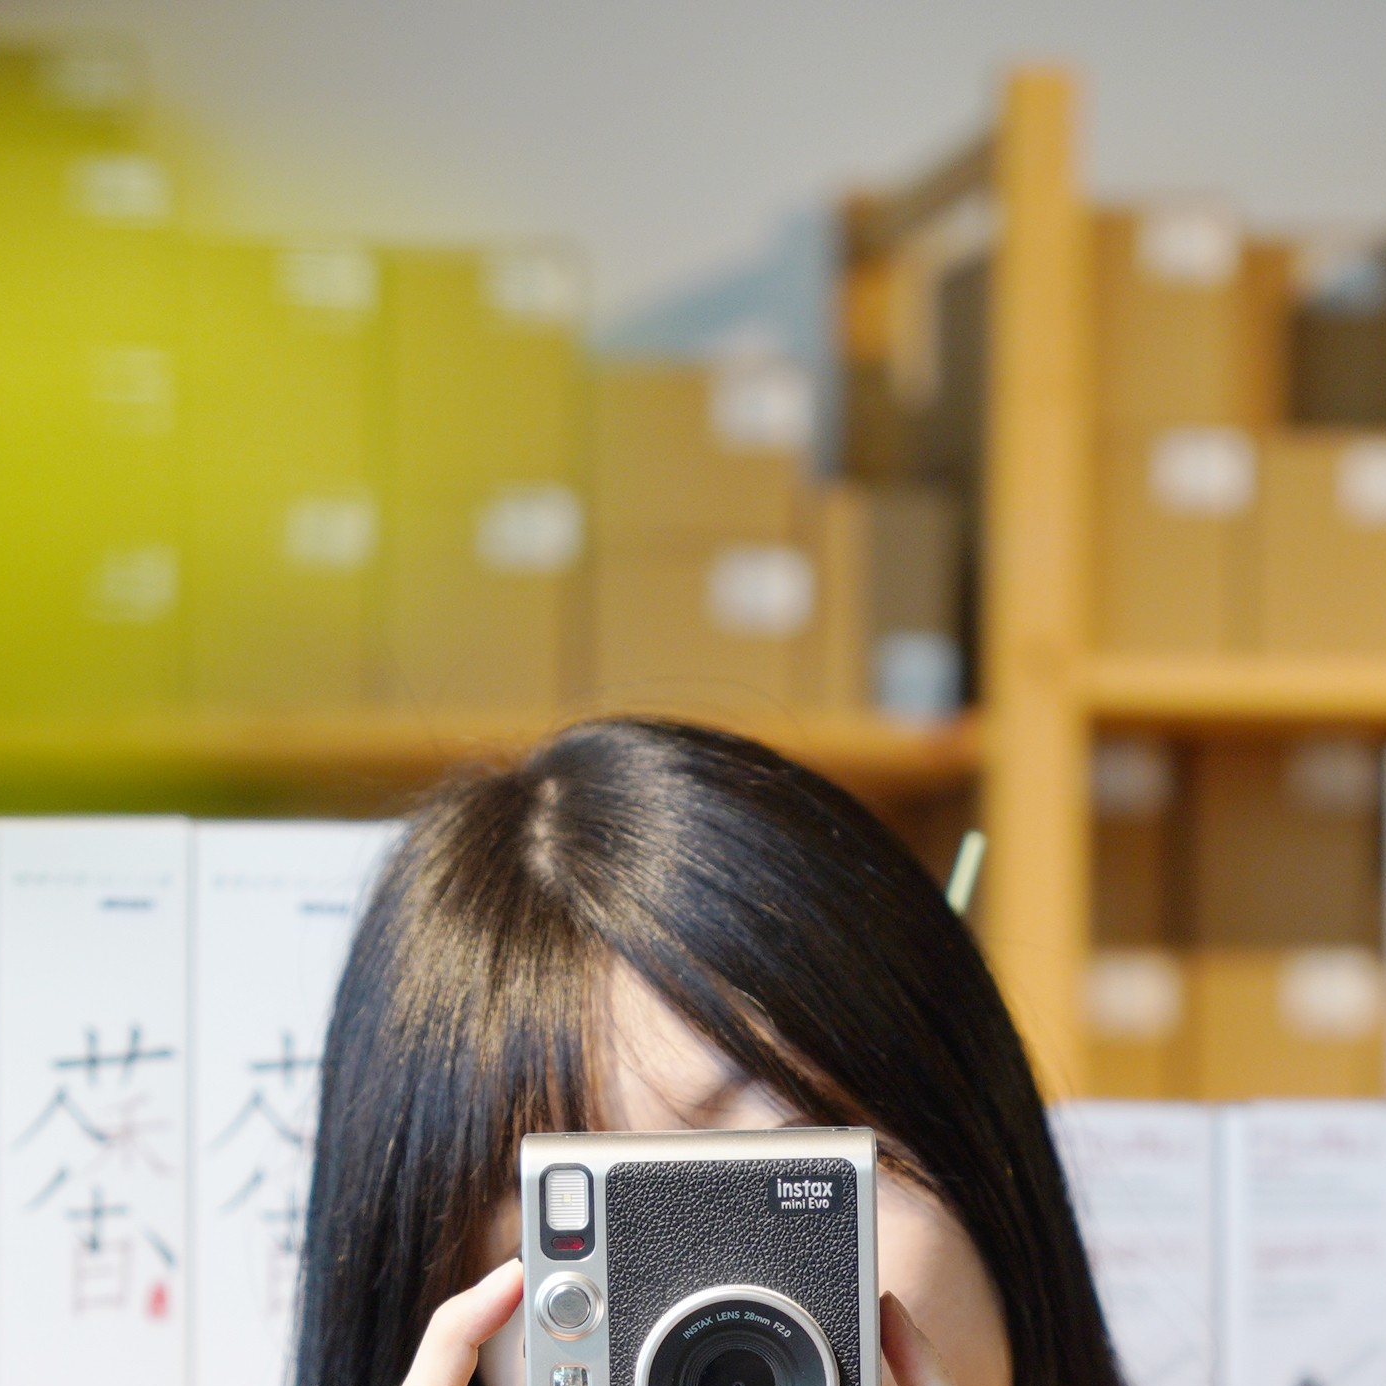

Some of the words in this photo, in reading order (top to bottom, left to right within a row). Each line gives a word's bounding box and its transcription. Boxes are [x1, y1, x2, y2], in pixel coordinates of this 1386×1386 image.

[776, 1178, 833, 1198] instax
[780, 1199, 806, 1210] mini
[808, 1196, 830, 1209] Evo
[682, 1315, 713, 1340] INSTAX
[716, 1310, 741, 1322] LENS
[744, 1311, 771, 1326] 28mm
[773, 1321, 792, 1338] F2.0
